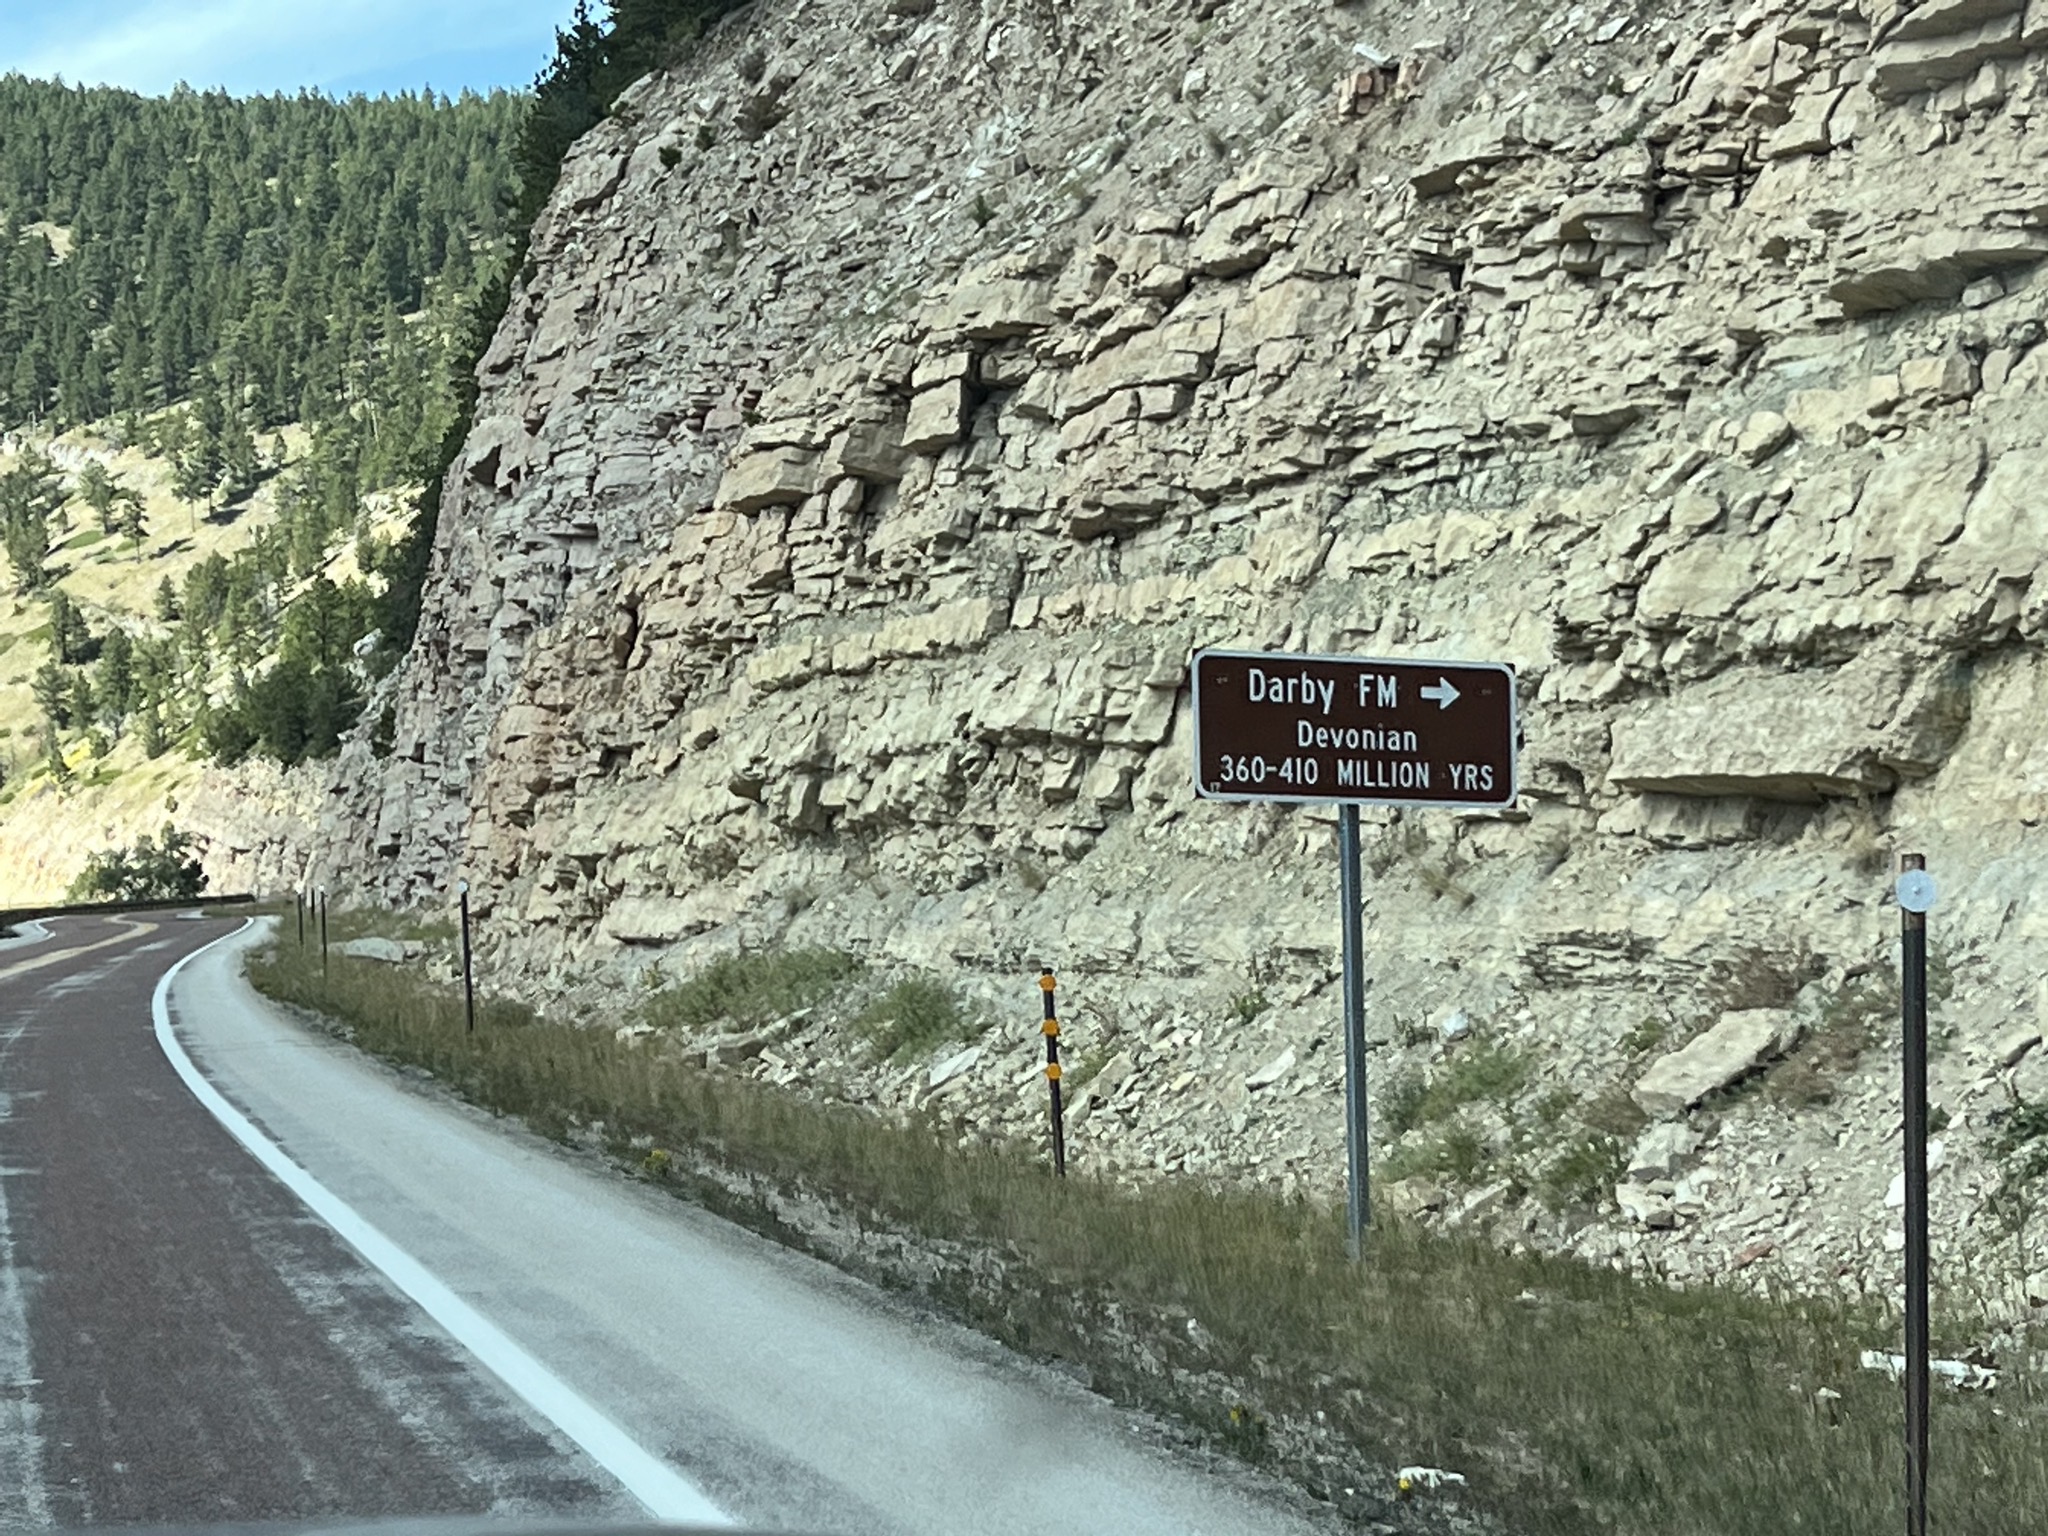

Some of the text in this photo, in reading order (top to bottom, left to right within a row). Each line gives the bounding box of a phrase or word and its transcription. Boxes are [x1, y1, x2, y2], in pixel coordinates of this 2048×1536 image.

[1249, 668, 1398, 715] Darby FM
[1297, 720, 1417, 752] Devonian
[1220, 754, 1494, 791] 360-410 MILLION YRS
